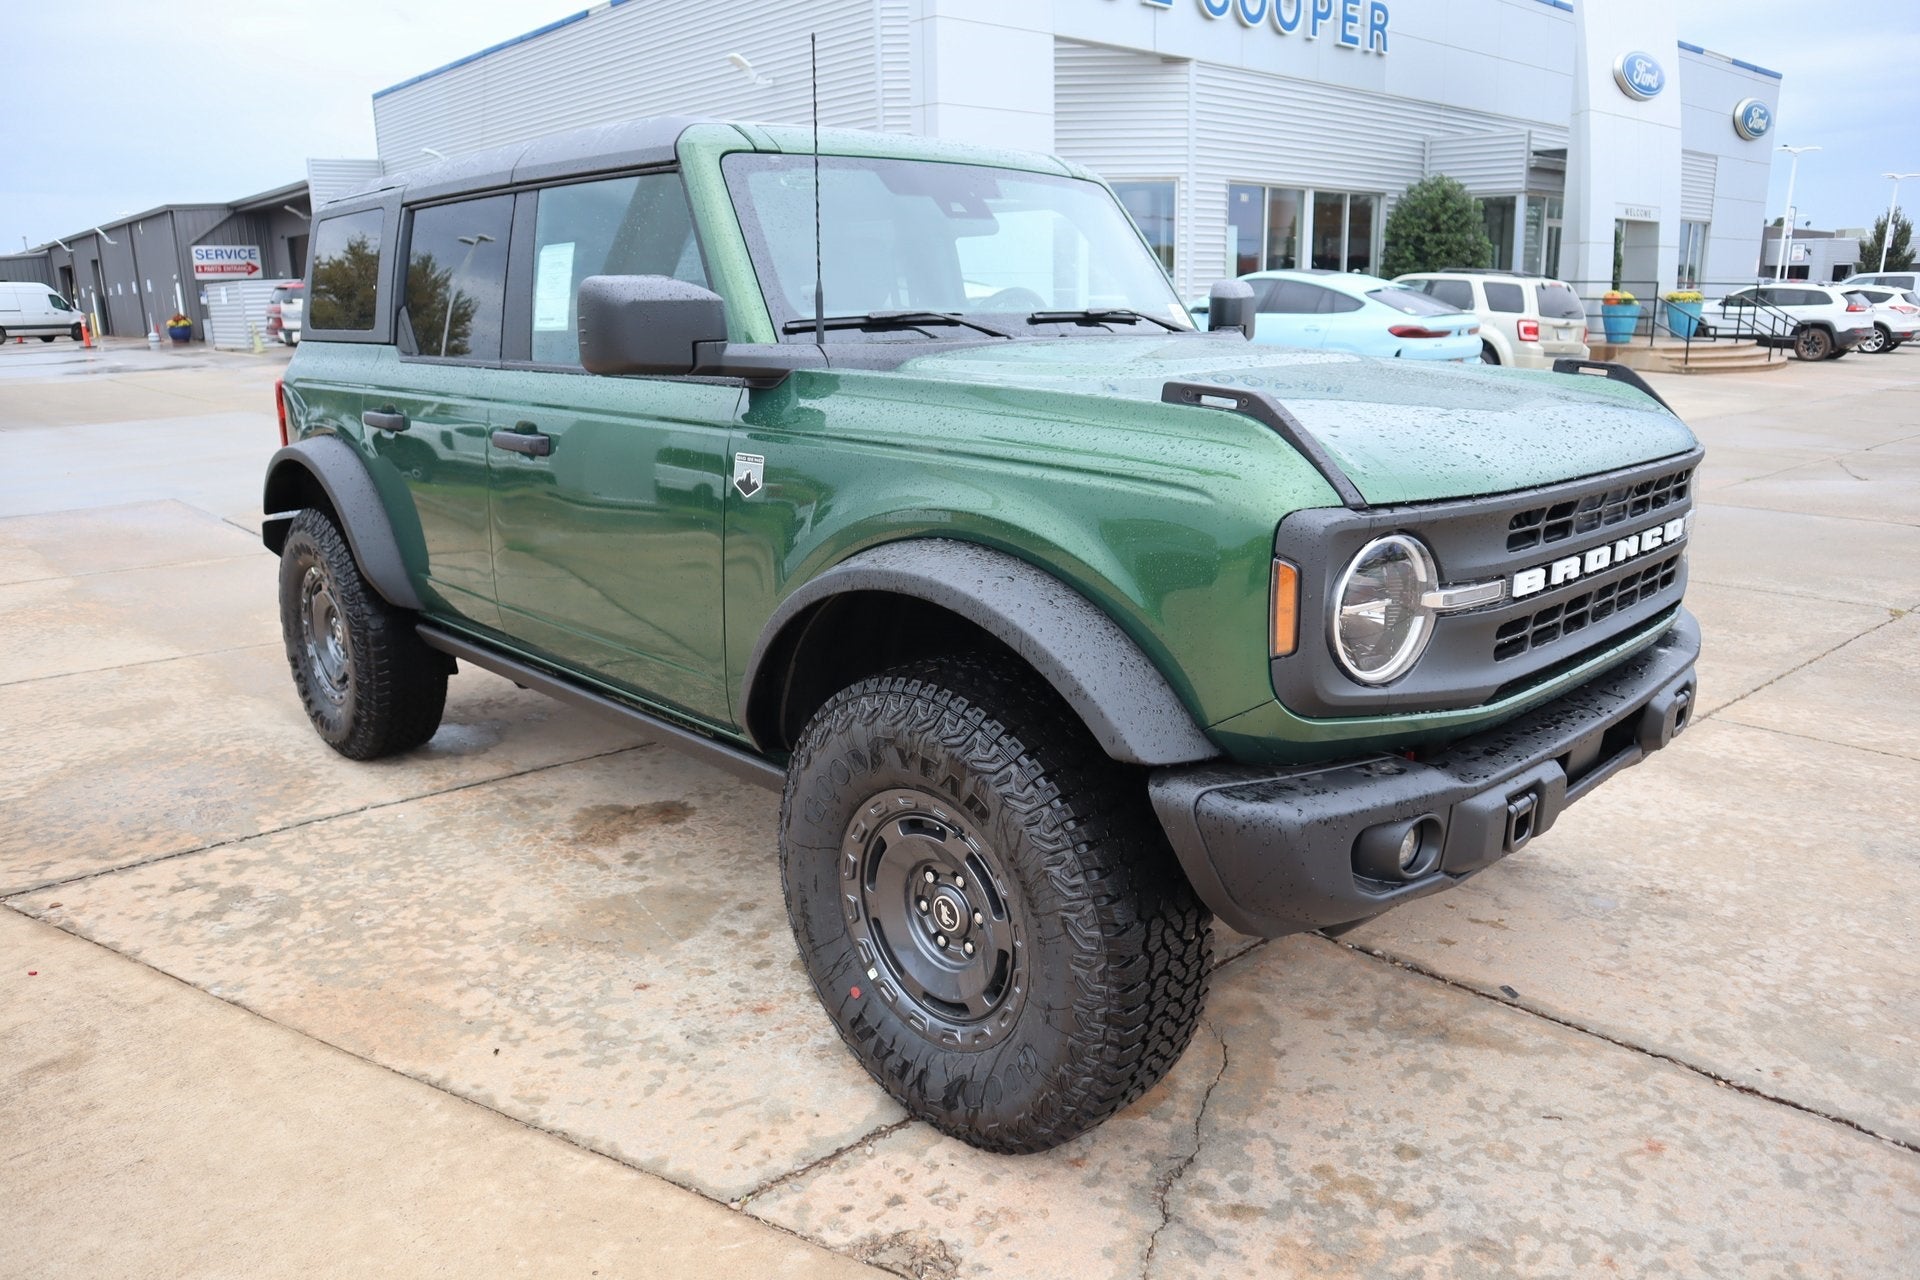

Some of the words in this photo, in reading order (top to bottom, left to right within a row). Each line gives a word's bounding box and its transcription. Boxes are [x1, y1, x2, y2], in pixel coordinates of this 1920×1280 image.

[1633, 58, 1659, 89] Ford
[1748, 106, 1768, 130] Ford
[195, 248, 257, 261] SERVICE
[204, 265, 222, 273] PARTS
[223, 265, 252, 273] ENTRANCE
[1512, 517, 1684, 599] BRONCO
[805, 747, 990, 826] GOODYEAR
